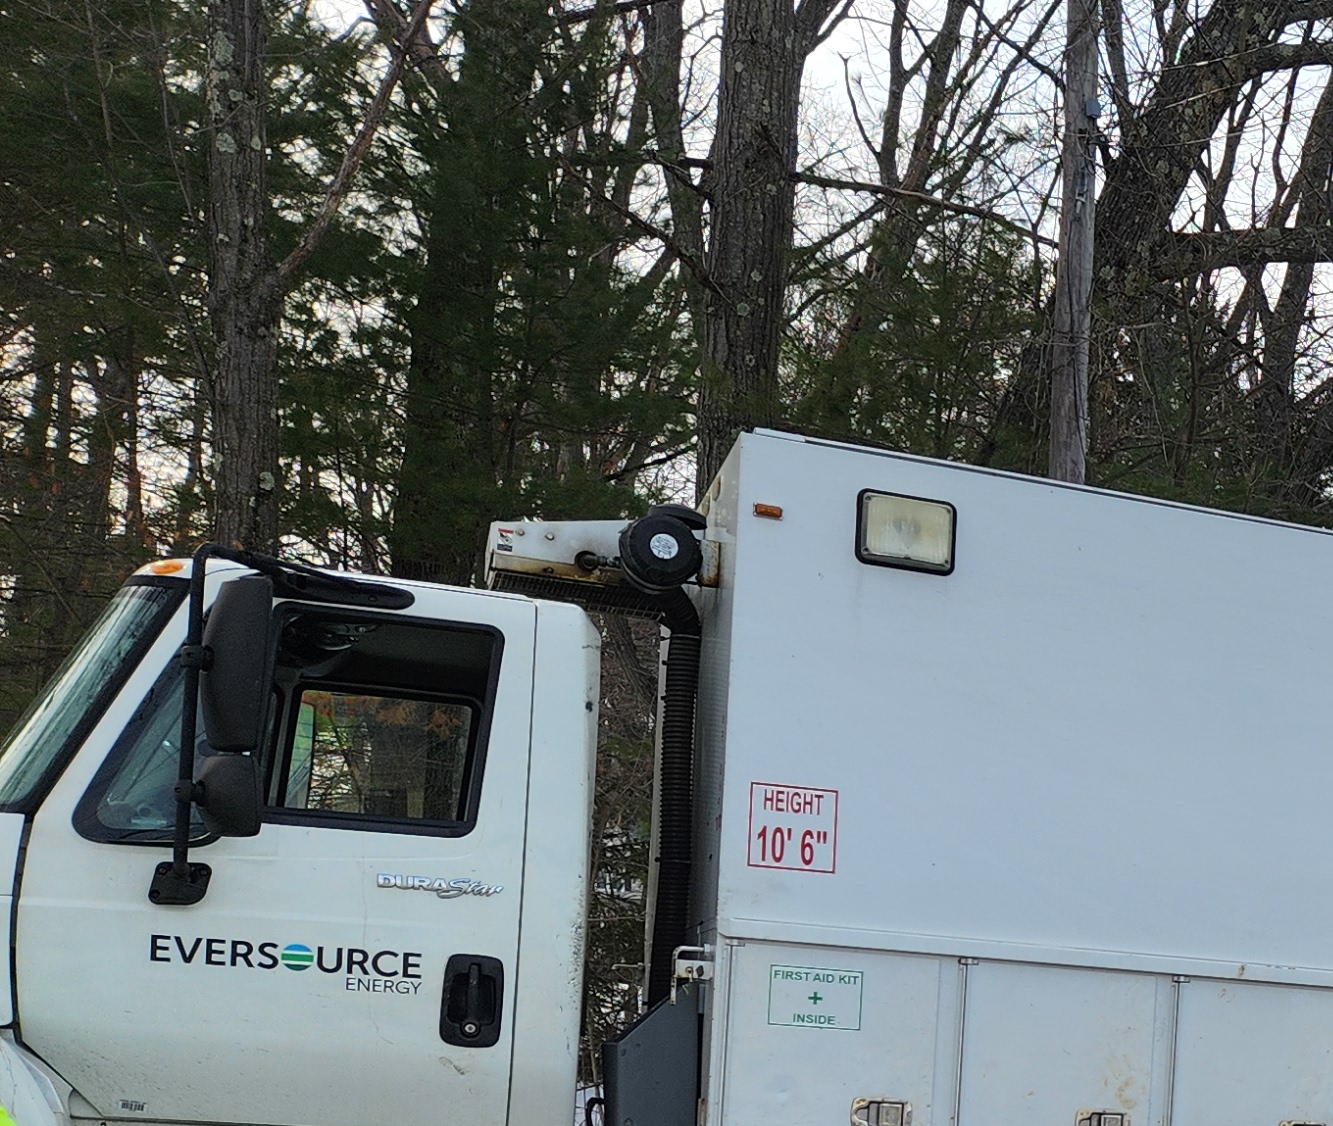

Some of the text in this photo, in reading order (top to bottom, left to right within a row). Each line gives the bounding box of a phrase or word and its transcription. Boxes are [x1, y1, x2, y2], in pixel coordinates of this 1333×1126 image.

[763, 788, 824, 816] HEIGHT
[757, 825, 828, 866] 10' 6"
[149, 934, 422, 979] EVERSOURCE
[345, 977, 422, 995] ENERGY
[773, 969, 860, 986] FIRST AID KIT
[792, 1012, 836, 1026] INSIDE
